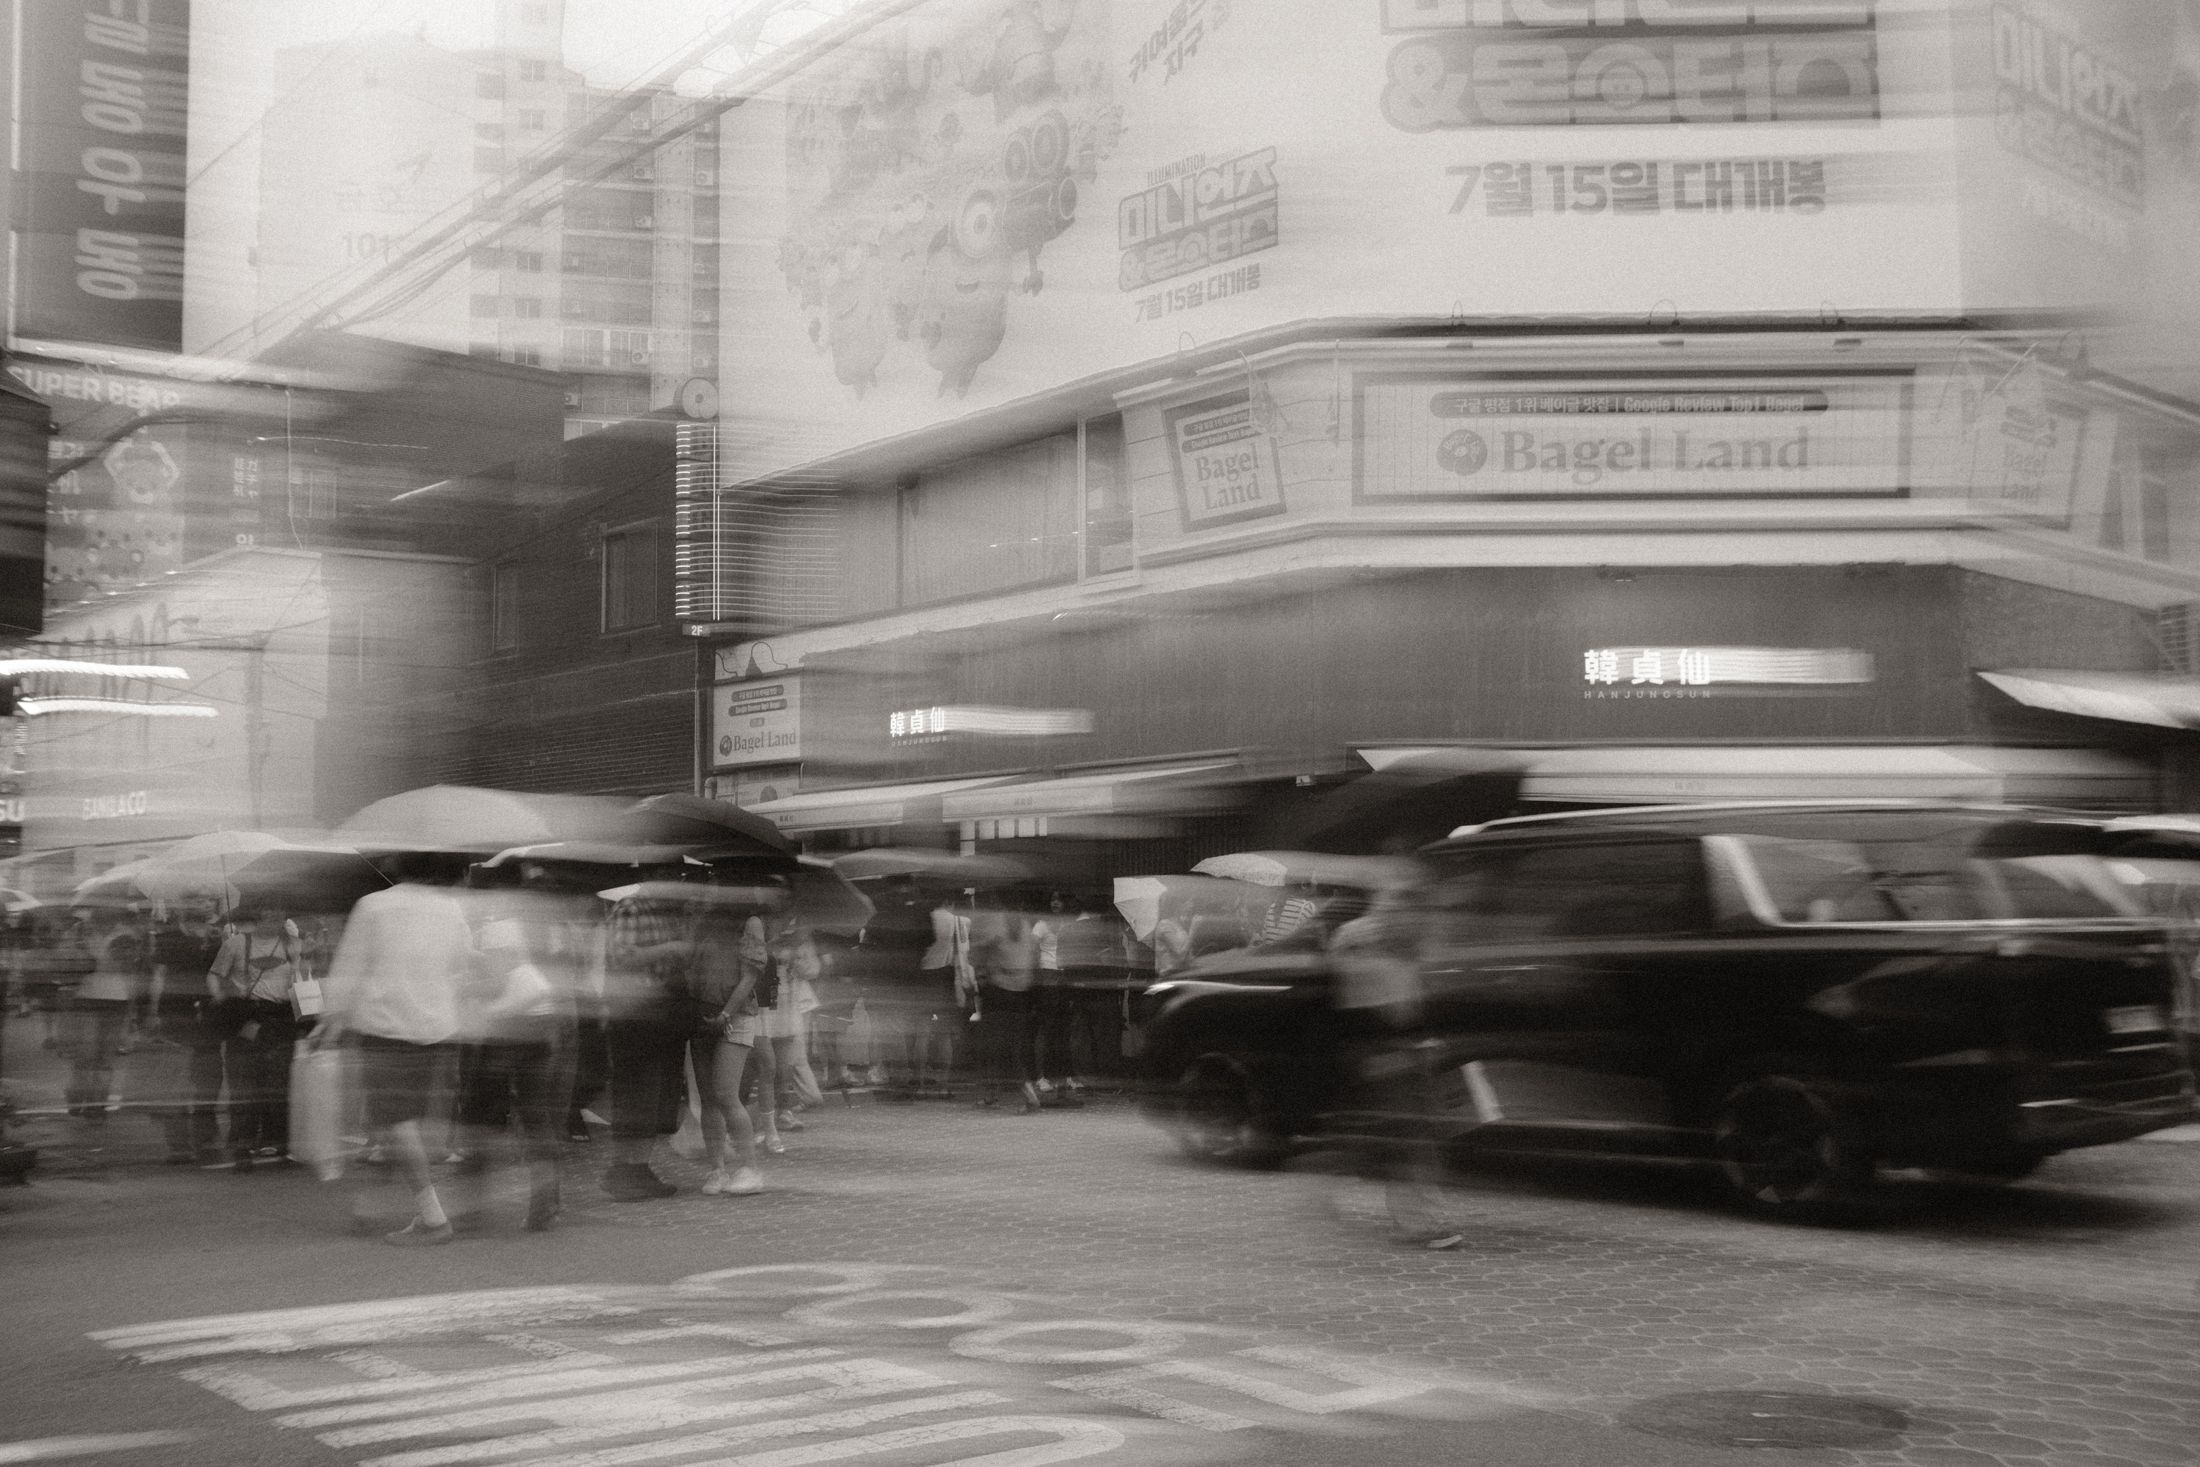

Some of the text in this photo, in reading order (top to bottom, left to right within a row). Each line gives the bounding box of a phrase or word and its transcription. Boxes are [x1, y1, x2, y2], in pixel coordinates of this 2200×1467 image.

[1119, 146, 1279, 251] 미니언즈
[1445, 160, 1827, 217] 7월 15일 대개봉
[1135, 262, 1261, 322] 7월 15일 대개봉
[1194, 442, 1259, 482] Bagel
[1500, 426, 1652, 486] Bagel
[1673, 426, 1809, 472] Land
[1201, 472, 1262, 510] Land
[691, 625, 703, 636] 2F
[1584, 648, 1711, 685] 韓貞仙
[1584, 690, 1711, 700] HANJUNGSUN
[733, 728, 797, 754] Bagel Land
[890, 706, 945, 738] 韓貞仙
